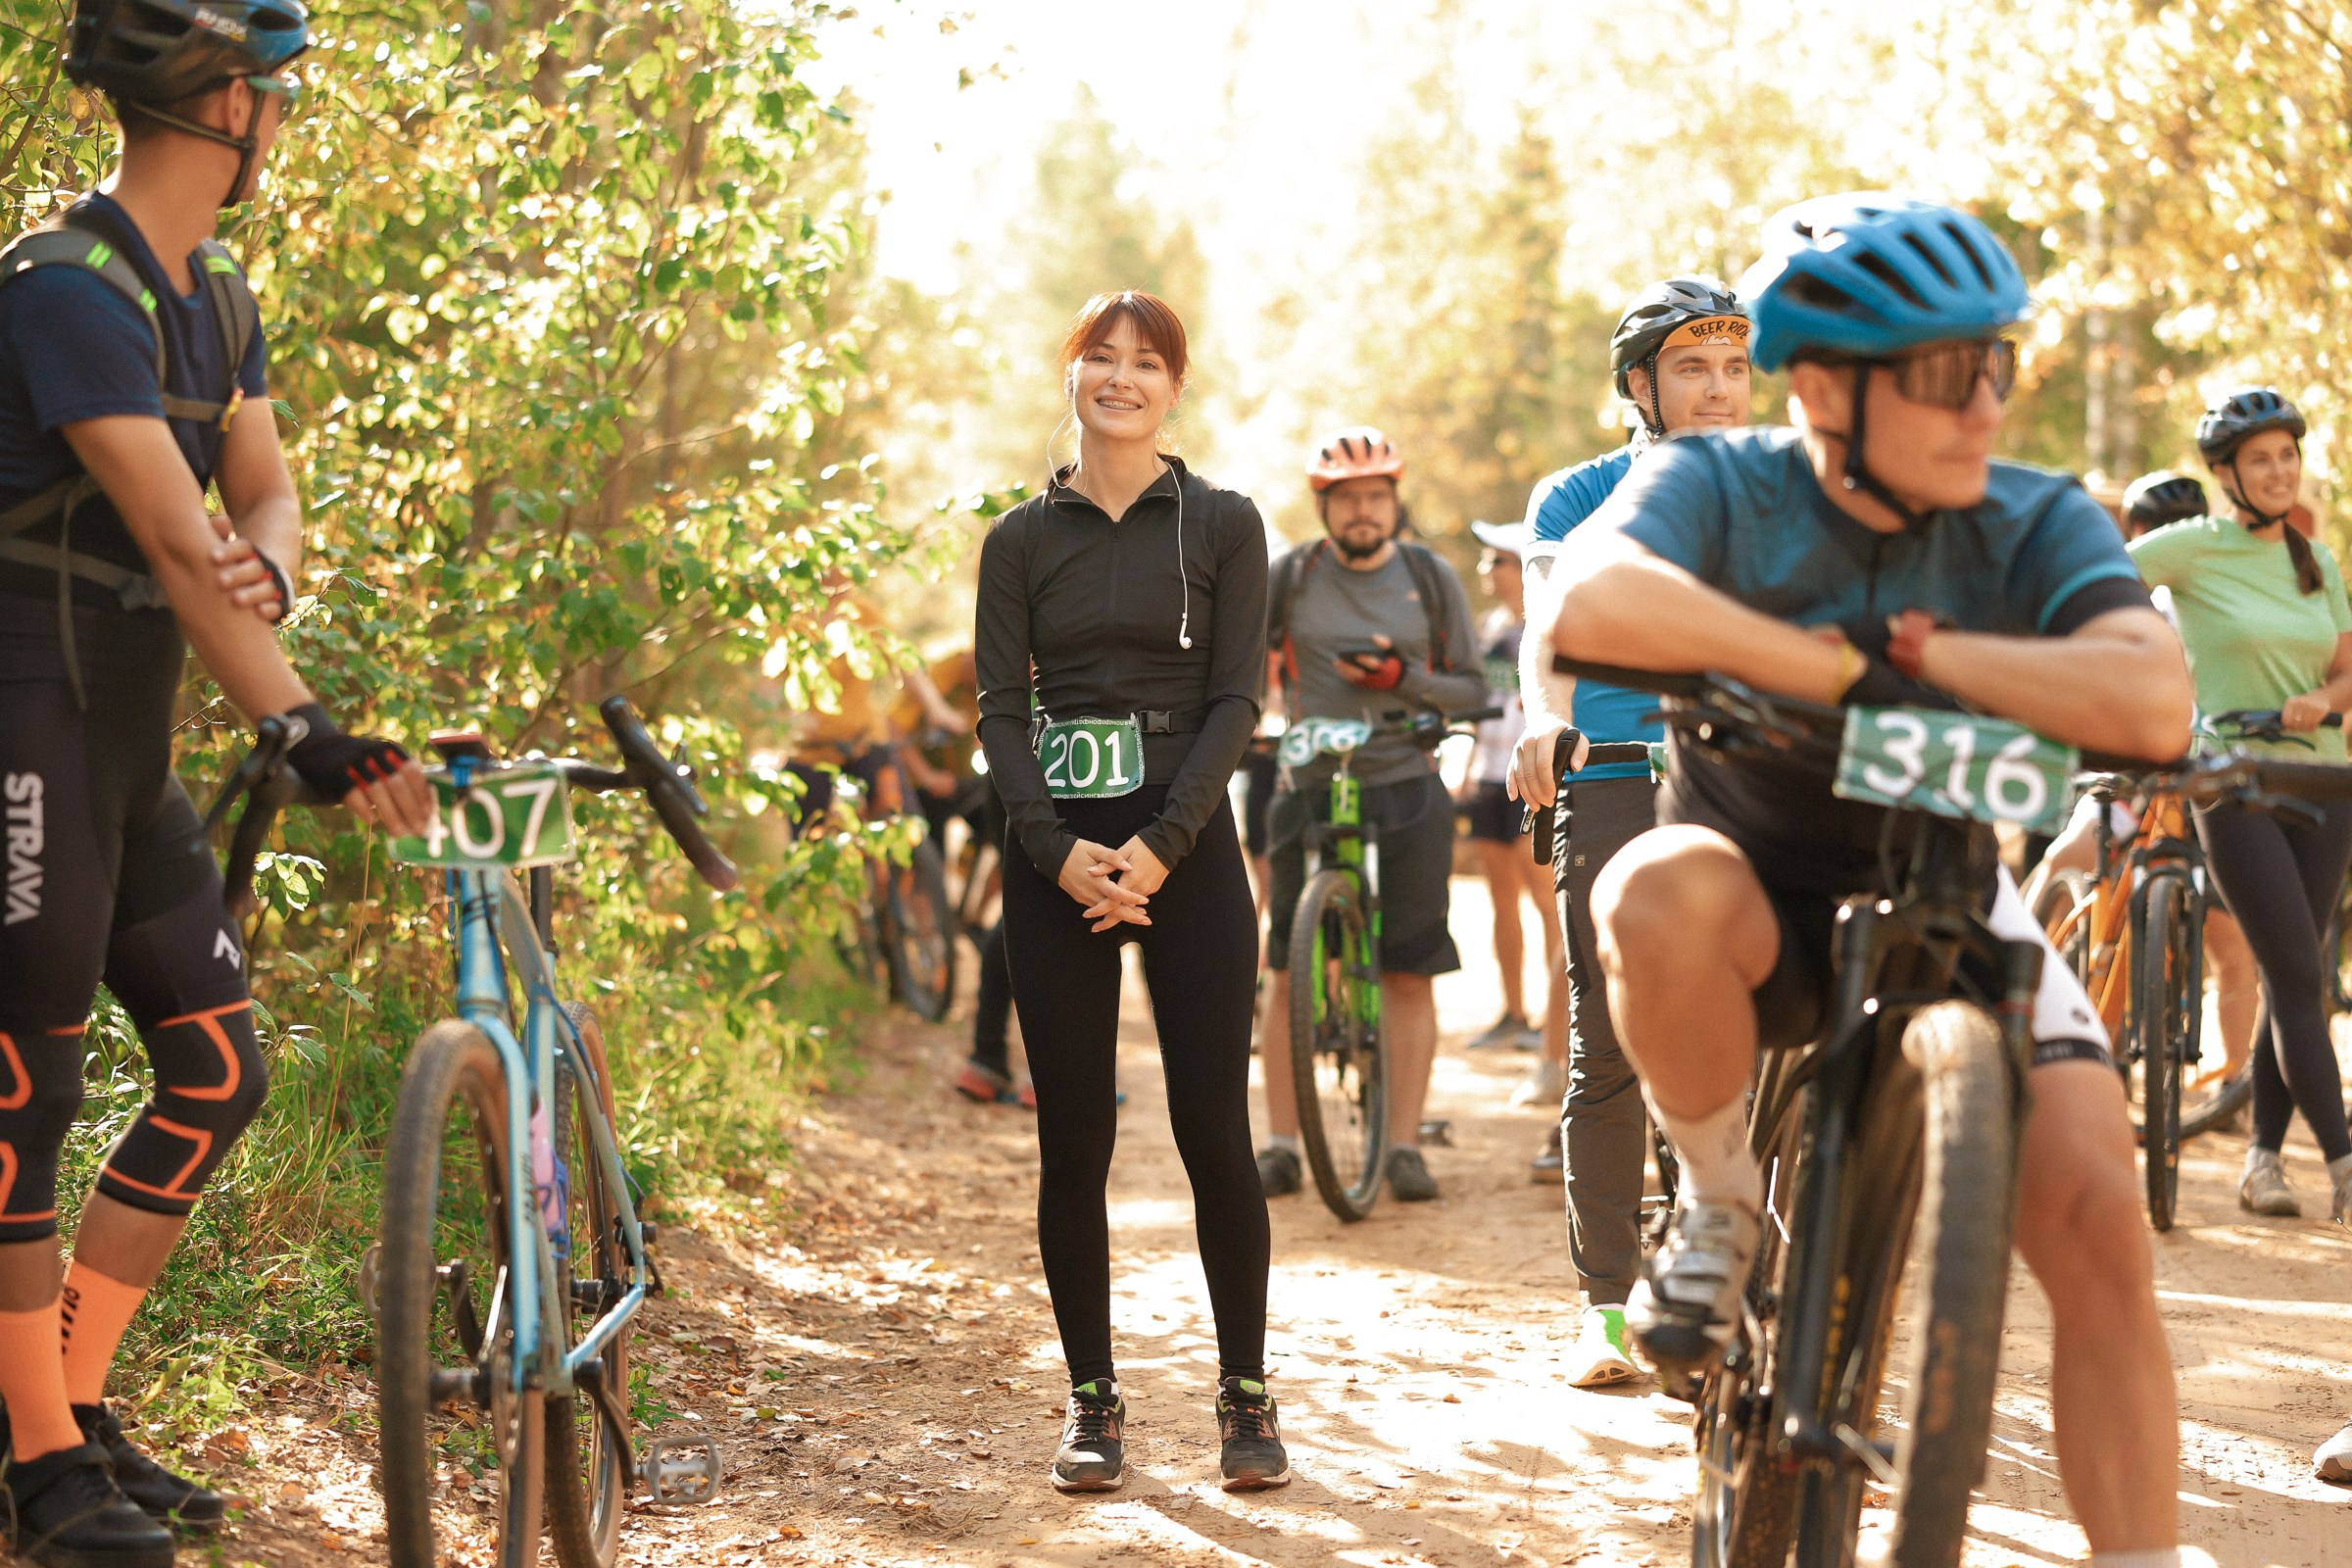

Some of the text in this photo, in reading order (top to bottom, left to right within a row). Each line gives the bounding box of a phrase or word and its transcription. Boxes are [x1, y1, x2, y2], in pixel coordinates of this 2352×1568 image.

[1688, 320, 1725, 337] BEER
[1044, 730, 1129, 788] 201
[1862, 710, 2047, 820] 316
[4, 771, 45, 926] STRAVA
